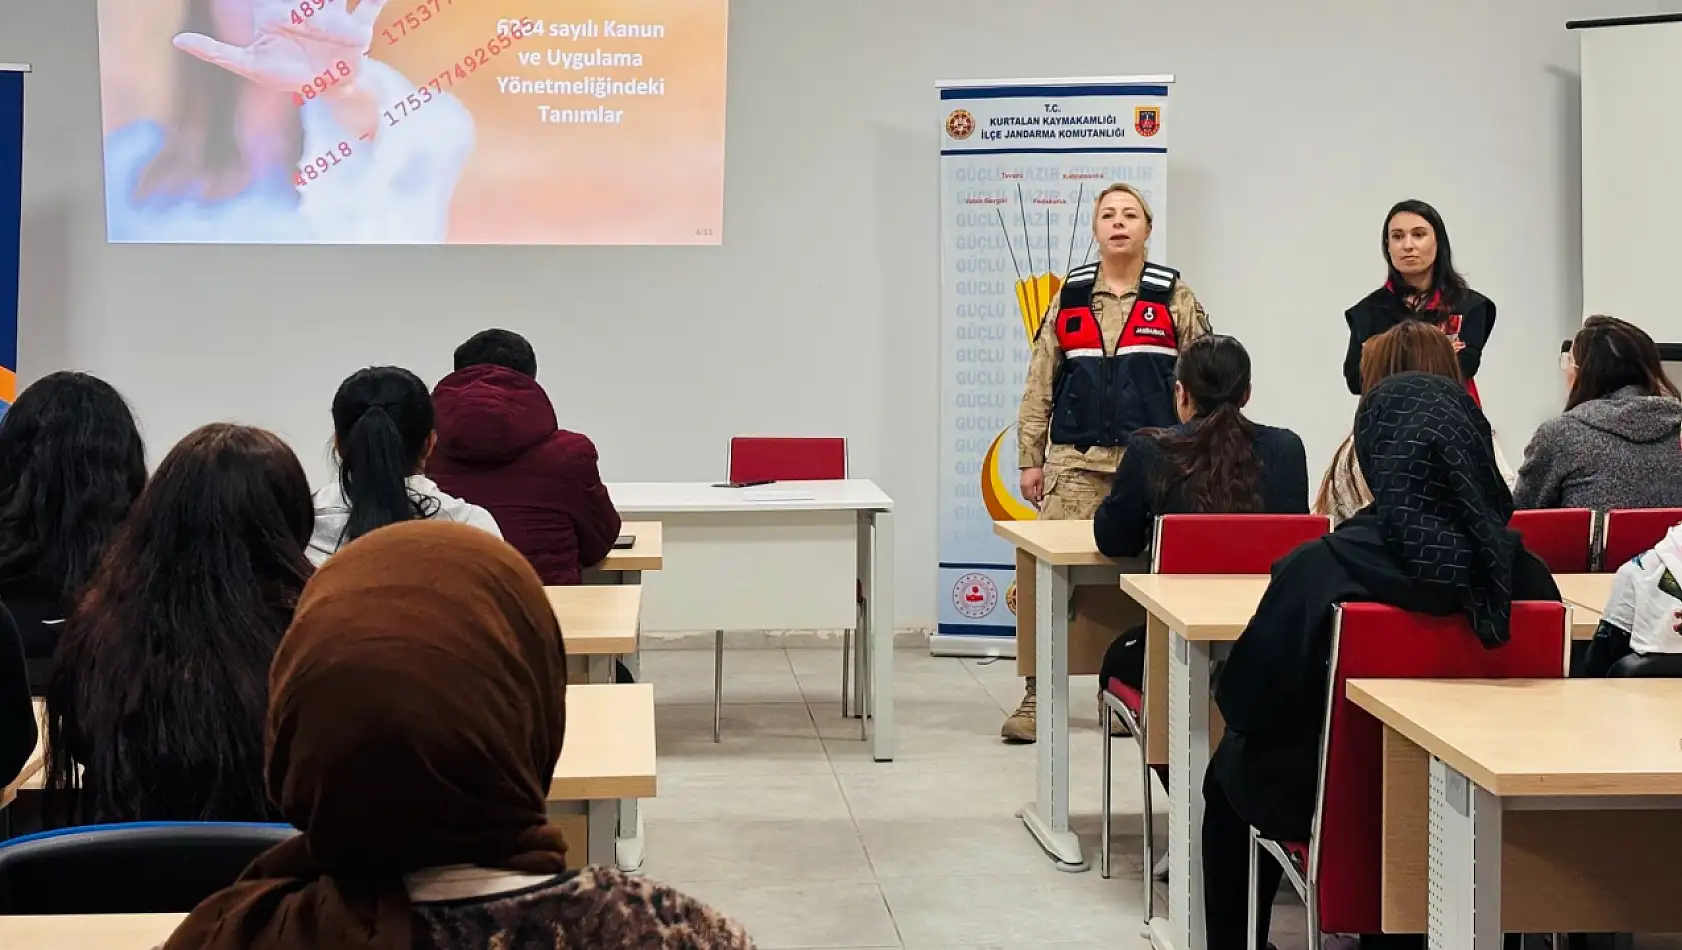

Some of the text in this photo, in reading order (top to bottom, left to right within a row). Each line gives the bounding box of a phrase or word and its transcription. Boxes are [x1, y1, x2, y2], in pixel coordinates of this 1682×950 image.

[549, 19, 598, 41] sayılı
[603, 20, 665, 38] Kanun
[518, 48, 644, 70] ve Uygulama
[496, 76, 665, 99] Yönetmeliğindeki
[537, 105, 624, 124] Tanımlar
[1044, 103, 1062, 113] T.C.
[990, 114, 1117, 127] KURTALAN KAYMAKAMLIĞI
[981, 127, 1125, 141] İLÇE JANDARMA KOMUTANLIĞI
